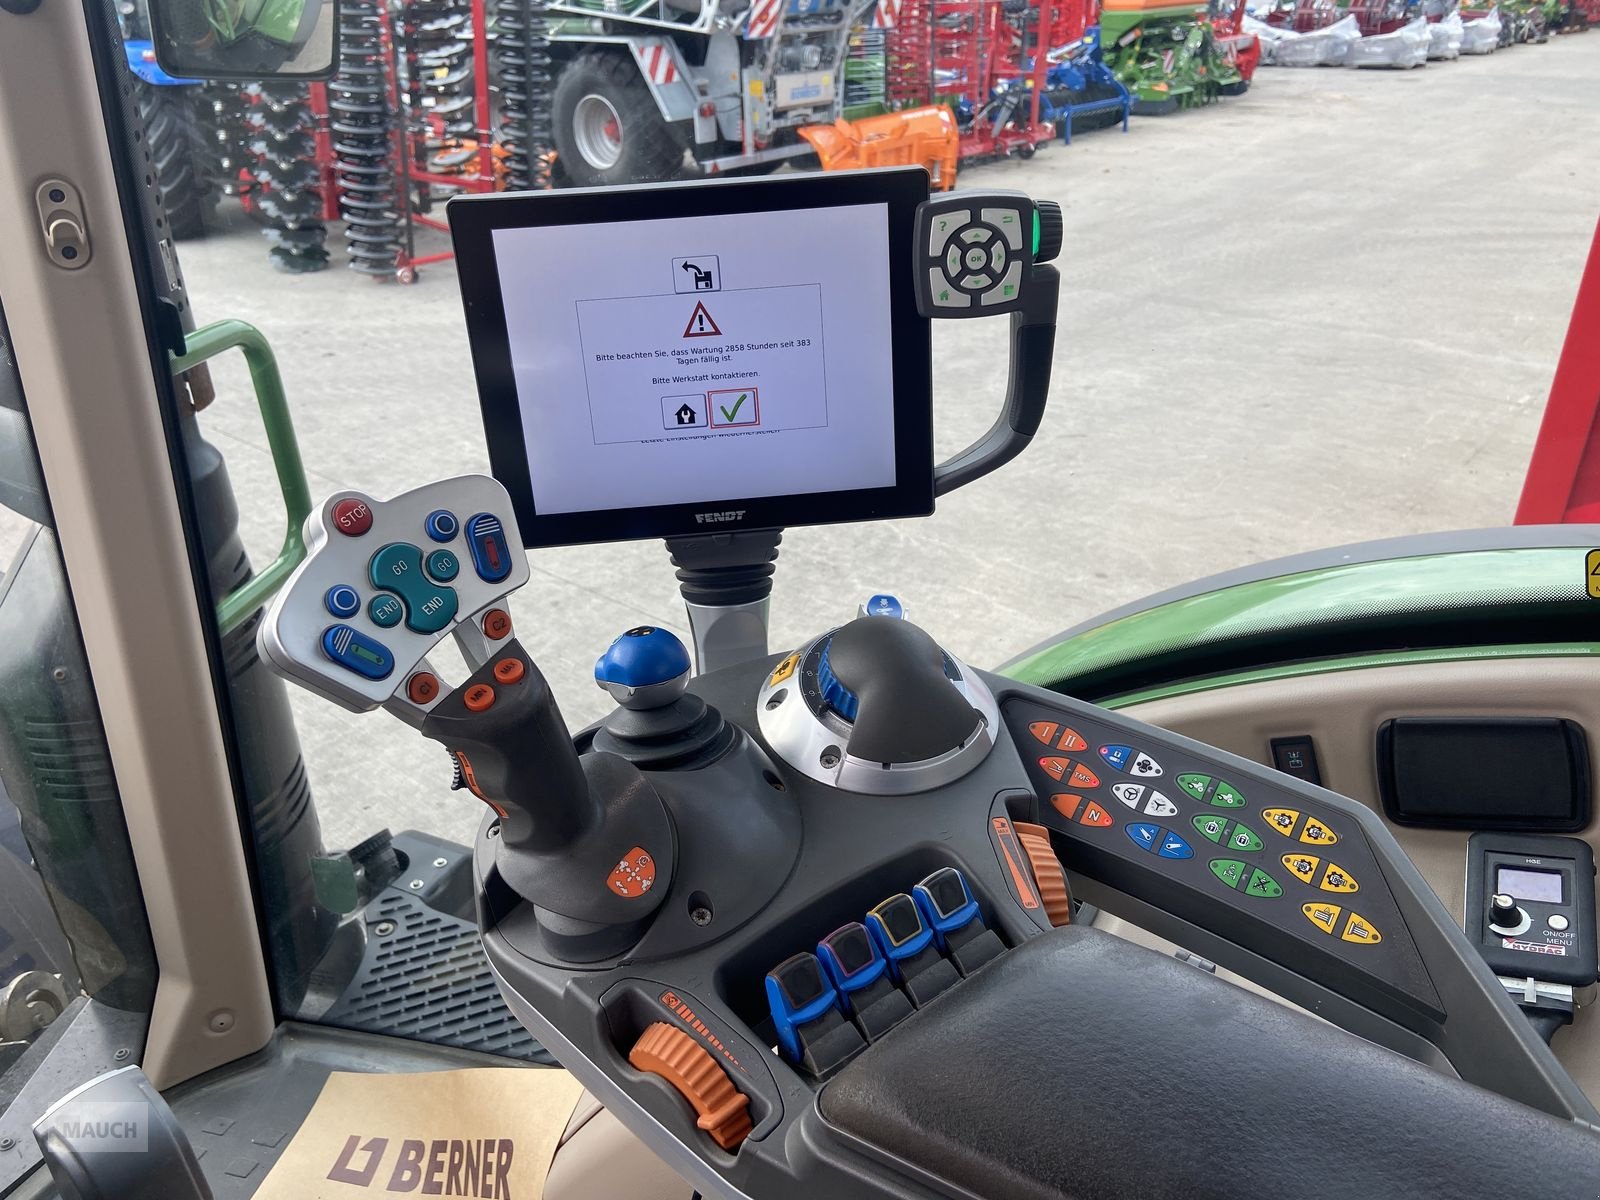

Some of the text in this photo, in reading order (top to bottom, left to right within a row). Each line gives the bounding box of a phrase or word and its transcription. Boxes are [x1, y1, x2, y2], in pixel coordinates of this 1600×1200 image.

[971, 255, 982, 263] OK
[596, 338, 811, 362] Bitte beachten Sie, dass Wartung 2858 Stunden seit 383
[676, 354, 733, 366] Tagen fällig ist.
[652, 371, 761, 385] Bitte Werkstatt kontaktieren.
[340, 504, 367, 528] STOP
[695, 510, 746, 523] FENDT
[392, 560, 408, 576] GO
[437, 557, 452, 572] GO
[375, 599, 399, 620] END
[421, 596, 444, 616] END
[470, 687, 488, 702] MIN
[1074, 771, 1091, 783] TMS
[1088, 809, 1100, 821] N
[1542, 930, 1576, 938] ON/OFF
[1546, 937, 1573, 946] MENU
[1512, 943, 1563, 955] HYDRAC
[386, 1138, 514, 1200] BERNER
